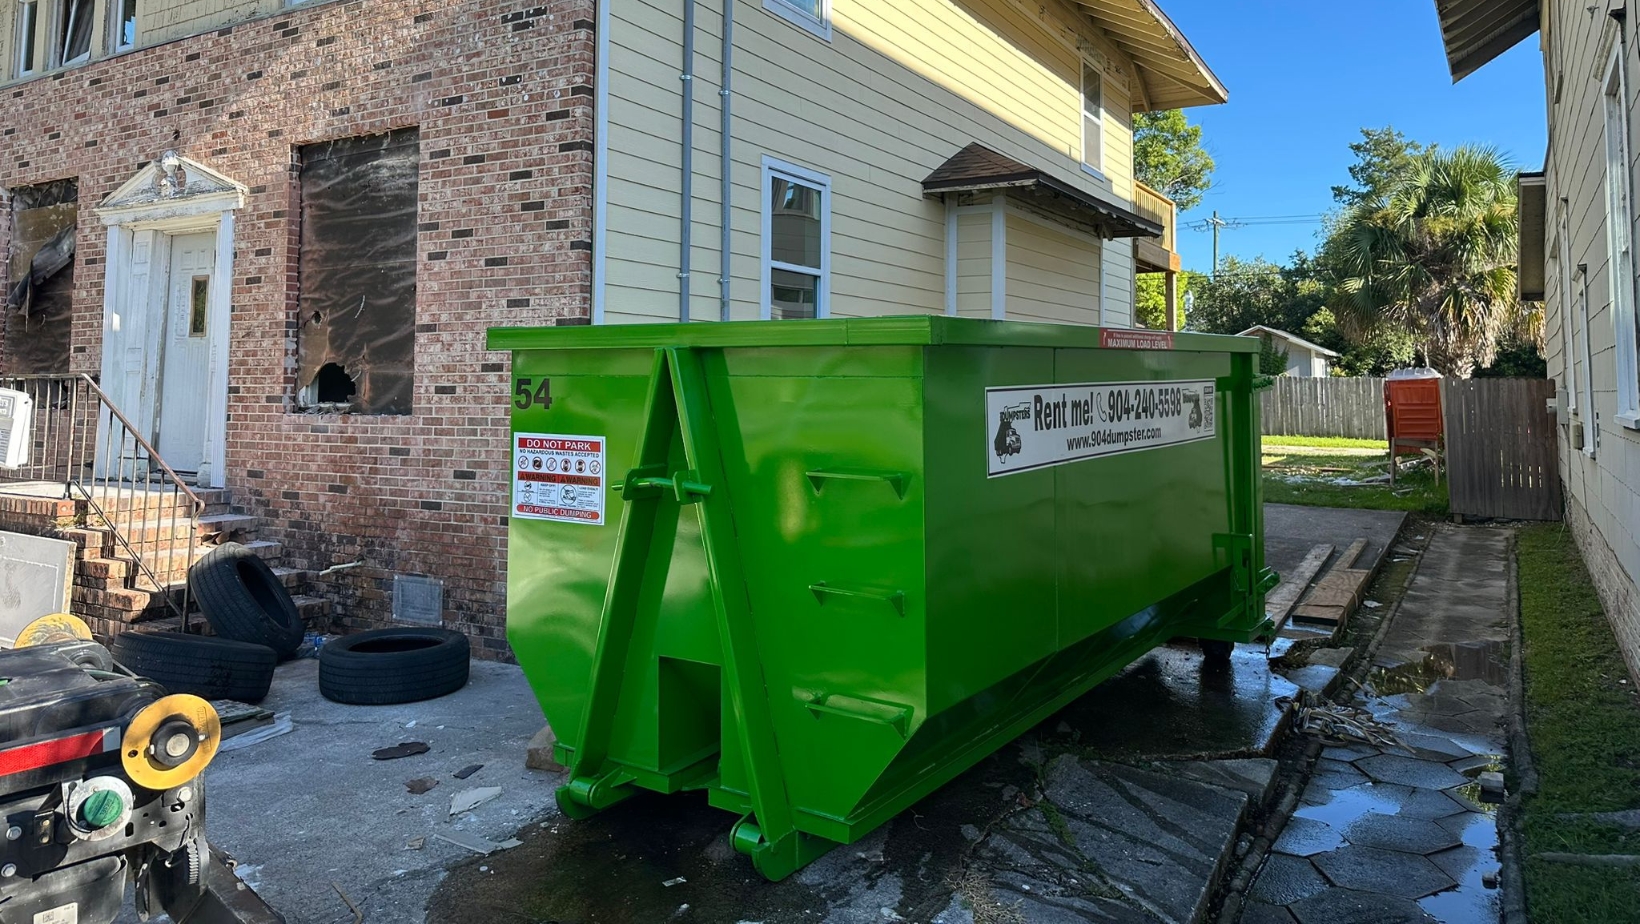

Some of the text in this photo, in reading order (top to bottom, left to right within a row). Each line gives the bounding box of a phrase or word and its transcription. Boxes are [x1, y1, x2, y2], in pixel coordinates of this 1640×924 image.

[1107, 338, 1167, 349] MAXIMUM LOAD LEVEL
[514, 378, 552, 410] 54
[1033, 387, 1182, 431] Rent me! 904-240-5598
[526, 439, 591, 451] DO NOT PARK
[1066, 427, 1162, 451] www.904dumpster.com
[574, 451, 600, 459] ACCEPTED
[525, 473, 556, 482] WARNING
[566, 475, 598, 485] WARNING
[523, 505, 592, 519] NO PUBLIC DUMPING
